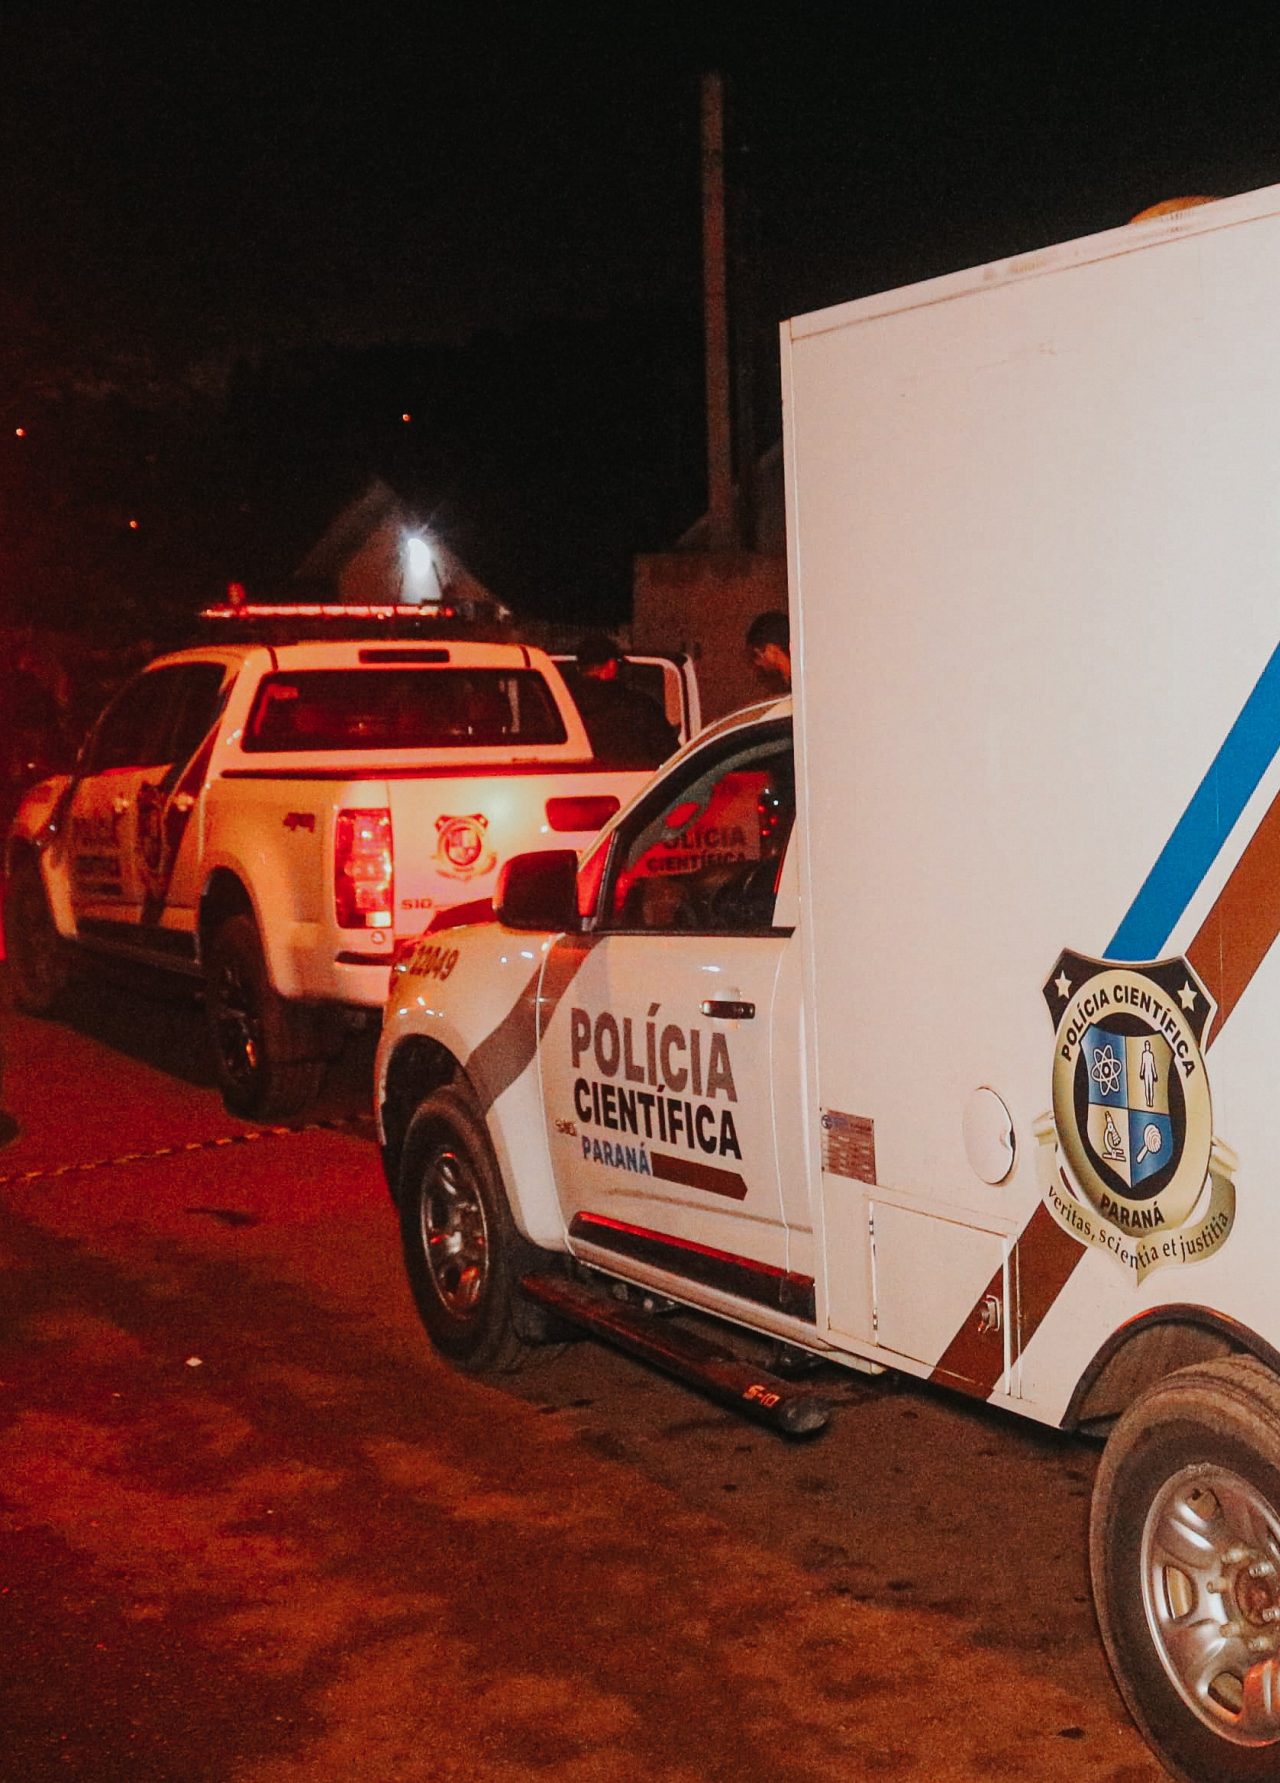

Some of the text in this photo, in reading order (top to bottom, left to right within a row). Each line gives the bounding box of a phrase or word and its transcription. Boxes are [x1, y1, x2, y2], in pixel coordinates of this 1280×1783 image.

[570, 1002, 739, 1104] POLÍCIA
[1061, 983, 1196, 1080] POLÍCIA CIENTÍFICA
[573, 1078, 743, 1161] CIENTÍFICA
[581, 1134, 651, 1176] PARANÁ
[1098, 1226, 1158, 1271] scientia
[1162, 1241, 1178, 1258] et
[1179, 1211, 1229, 1263] justitia
[1099, 1192, 1165, 1229] PARANÁ
